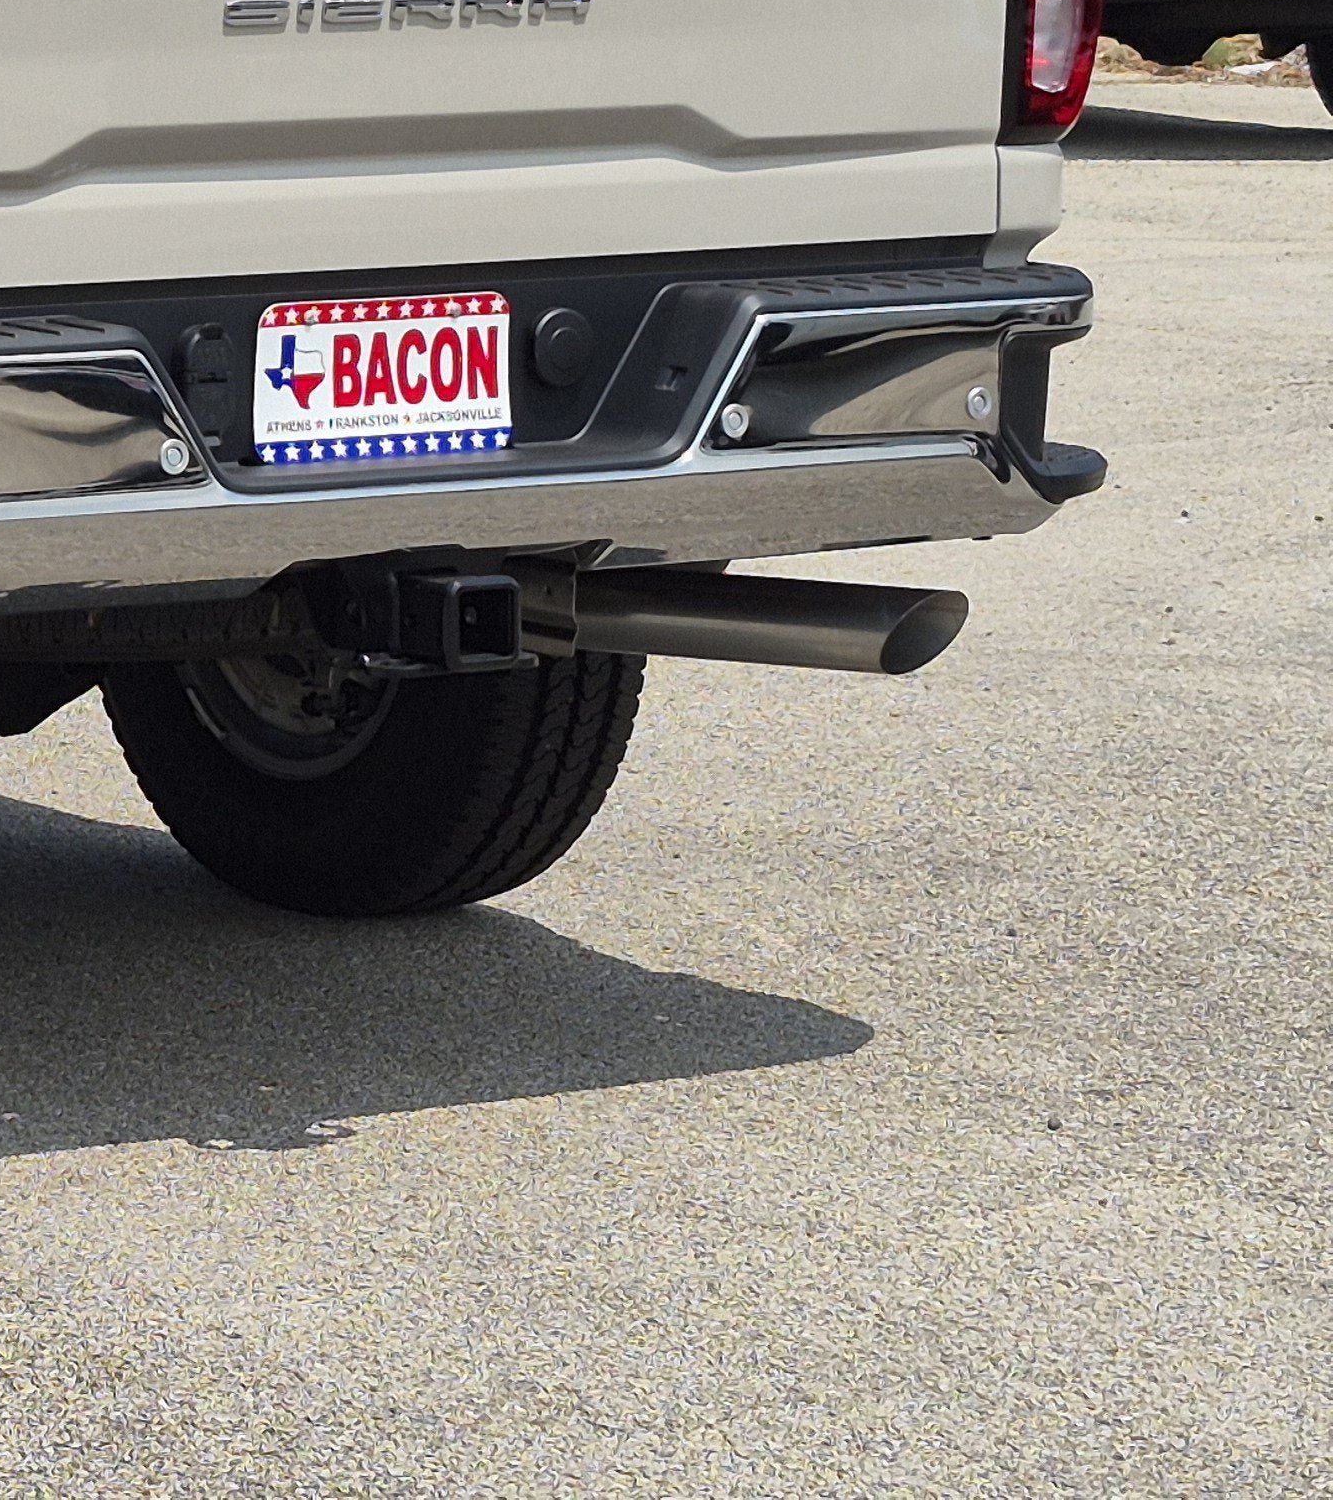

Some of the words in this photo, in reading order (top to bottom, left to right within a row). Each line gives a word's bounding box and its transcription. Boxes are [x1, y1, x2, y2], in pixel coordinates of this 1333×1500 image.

[333, 325, 499, 409] BACON
[266, 419, 312, 434] ATHENS
[415, 407, 503, 425] JACKSONVILLE
